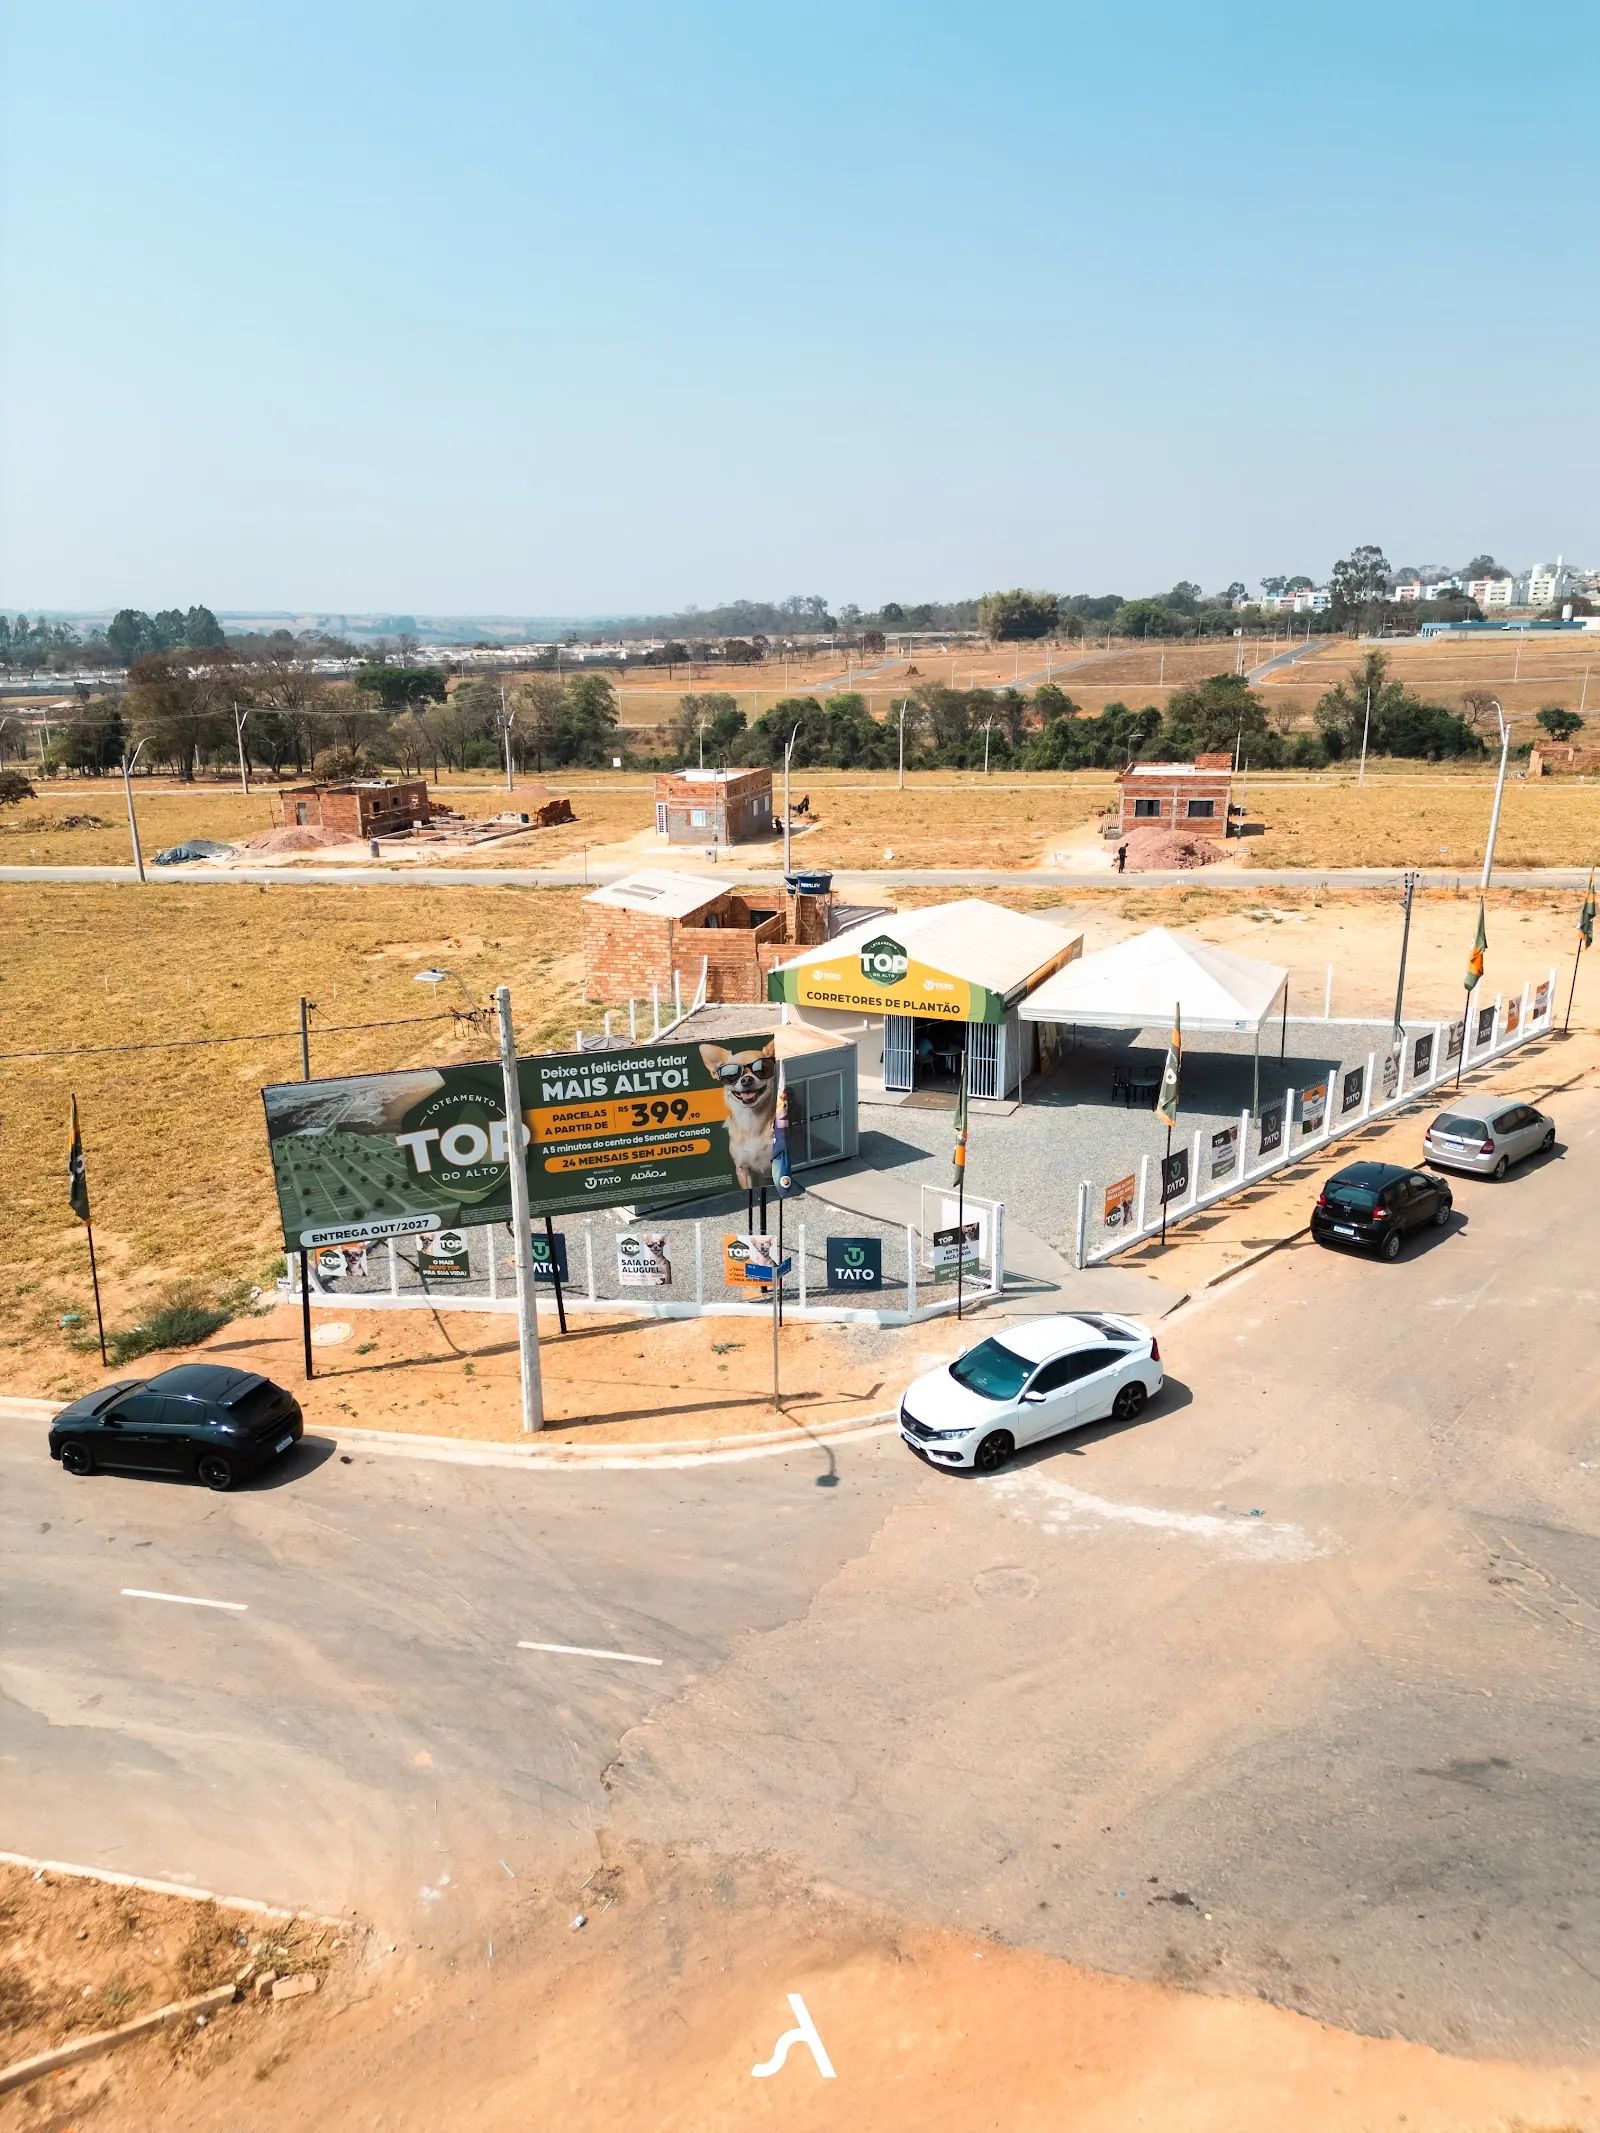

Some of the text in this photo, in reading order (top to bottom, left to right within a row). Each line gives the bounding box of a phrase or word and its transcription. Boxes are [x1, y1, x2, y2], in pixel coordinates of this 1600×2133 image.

[858, 953, 909, 974] TOP
[806, 991, 961, 1014] CORRETORES DE PLANTÃO
[541, 1055, 688, 1079] Deixe a felicidade falar
[542, 1068, 690, 1102] MAIS ALTO!
[427, 1094, 496, 1115] LOTEAMENTO
[1345, 1091, 1360, 1105] TATO
[552, 1109, 607, 1122] PARCELAS
[631, 1098, 689, 1127] 399
[554, 1123, 592, 1134] PARTIR
[594, 1121, 608, 1130] DE
[542, 1147, 549, 1155] A
[557, 1143, 591, 1153] minutos
[593, 1140, 604, 1148] do
[605, 1137, 632, 1147] centro
[633, 1135, 643, 1143] de
[644, 1132, 678, 1142] Senador
[679, 1127, 711, 1137] Canedo
[1263, 1131, 1280, 1146] TATO
[395, 1121, 531, 1173] TOP
[562, 1144, 695, 1168] 24 MENSAIS SEM JUROS
[441, 1166, 499, 1181] DO ALTO
[598, 1176, 622, 1185] TATO
[630, 1170, 659, 1181] ADÃO
[1166, 1178, 1185, 1194] TATO
[1106, 1212, 1121, 1223] TOP
[311, 1219, 430, 1243] ENTREGA OUT/2027
[440, 1240, 463, 1249] TOP
[937, 1235, 954, 1244] TOP
[621, 1244, 640, 1252] TOP
[727, 1248, 750, 1257] TOP
[946, 1245, 969, 1255] ENTRDA
[319, 1256, 340, 1266] TOP
[533, 1262, 560, 1273] ATO
[835, 1268, 875, 1280] TATO
